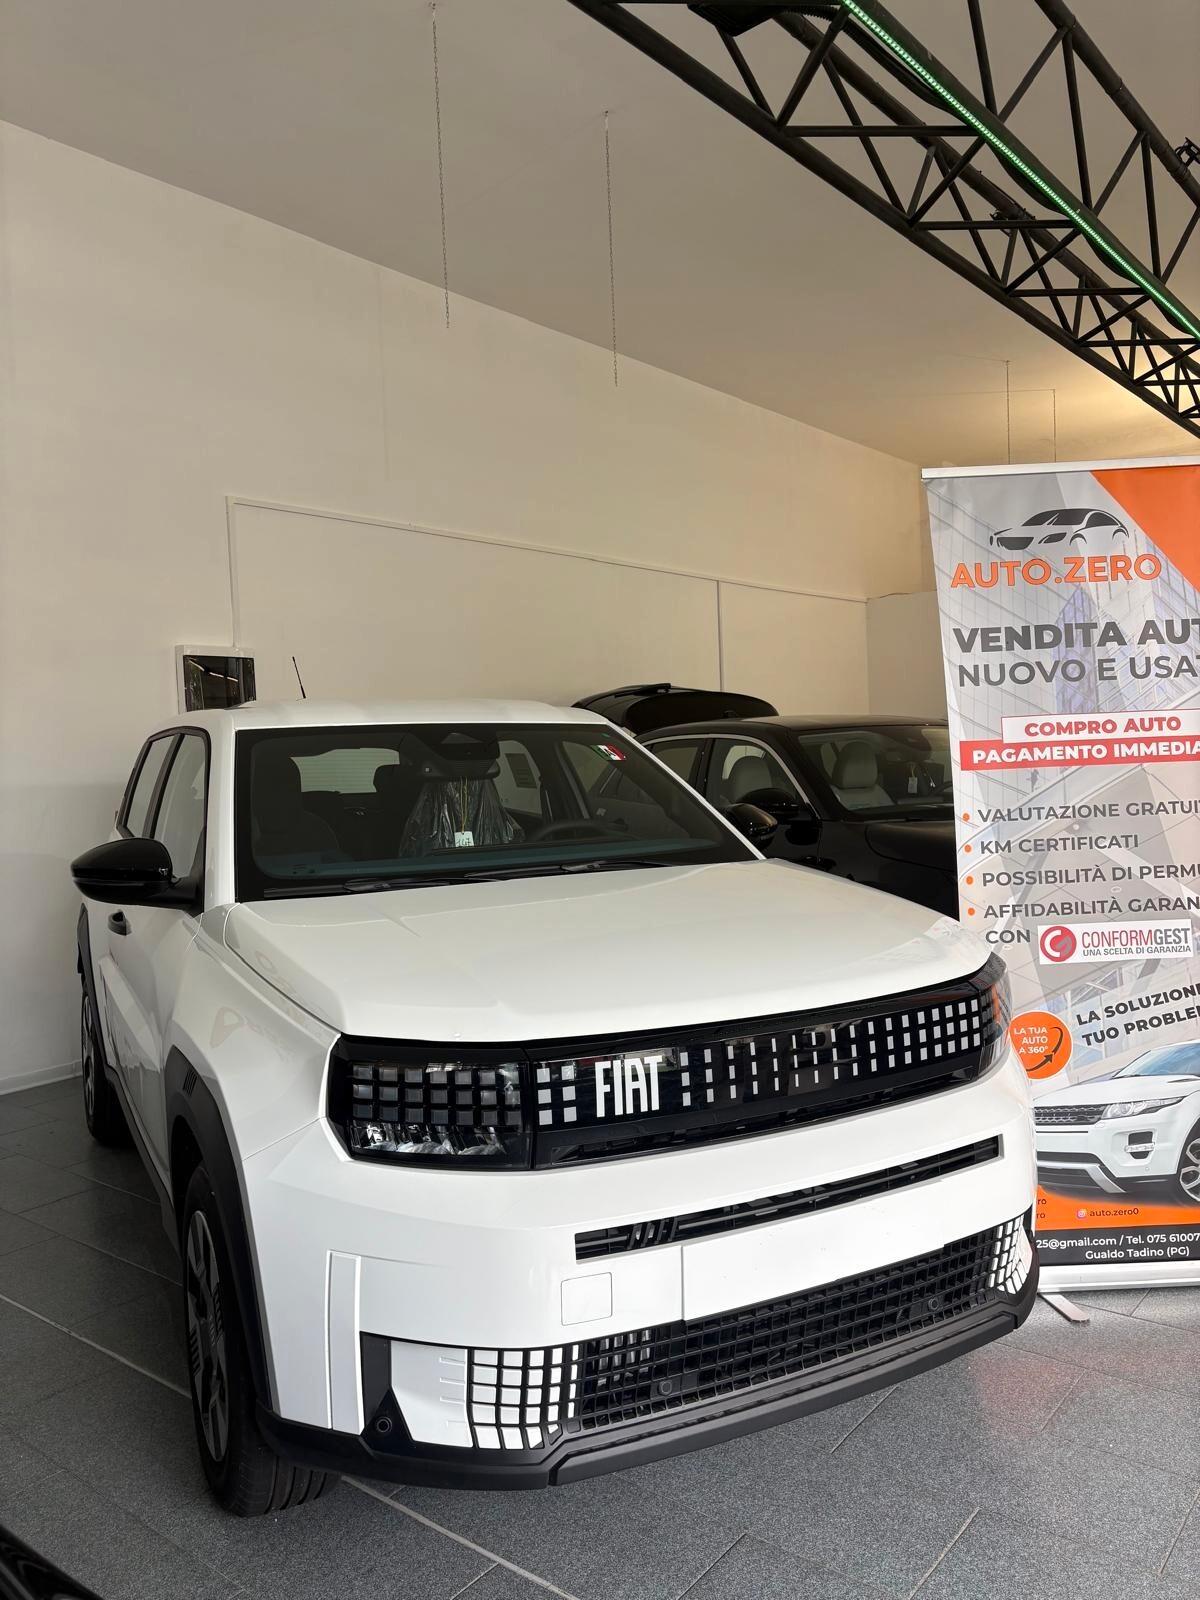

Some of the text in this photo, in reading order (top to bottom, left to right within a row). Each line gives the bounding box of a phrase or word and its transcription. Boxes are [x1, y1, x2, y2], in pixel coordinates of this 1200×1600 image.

[950, 553, 1162, 588] AUTO.ZERO
[952, 621, 1127, 653] VENDITA
[958, 655, 1200, 687] NUOVO E USA
[1024, 716, 1182, 737] COMPRO AUTO
[972, 744, 1107, 764] PAGAMENTO
[977, 799, 1200, 823] VALUTAZIONE GRATUI
[980, 834, 1139, 854] KM CERTIFICATI
[982, 863, 1200, 887] POSSIBILITÀ DI PERM
[983, 896, 1123, 919] AFFIDABILITÀ
[985, 930, 1031, 944] CON
[1081, 927, 1191, 949] CONFORMGEST
[1082, 945, 1191, 957] UNA SCELTA DI GARANZIA
[1076, 1010, 1101, 1026] LA
[1082, 1005, 1200, 1046] TUO PROBLE
[1014, 1027, 1026, 1035] LA
[1022, 1036, 1048, 1045] AUTO
[1027, 1045, 1049, 1054] 360°
[595, 1055, 663, 1118] FIAT
[1089, 1207, 1140, 1217] auto.zero0
[1126, 1235, 1145, 1245] Tel.
[1146, 1234, 1167, 1243] 075
[1085, 1247, 1190, 1260] Gualdo Tadino (PG)
